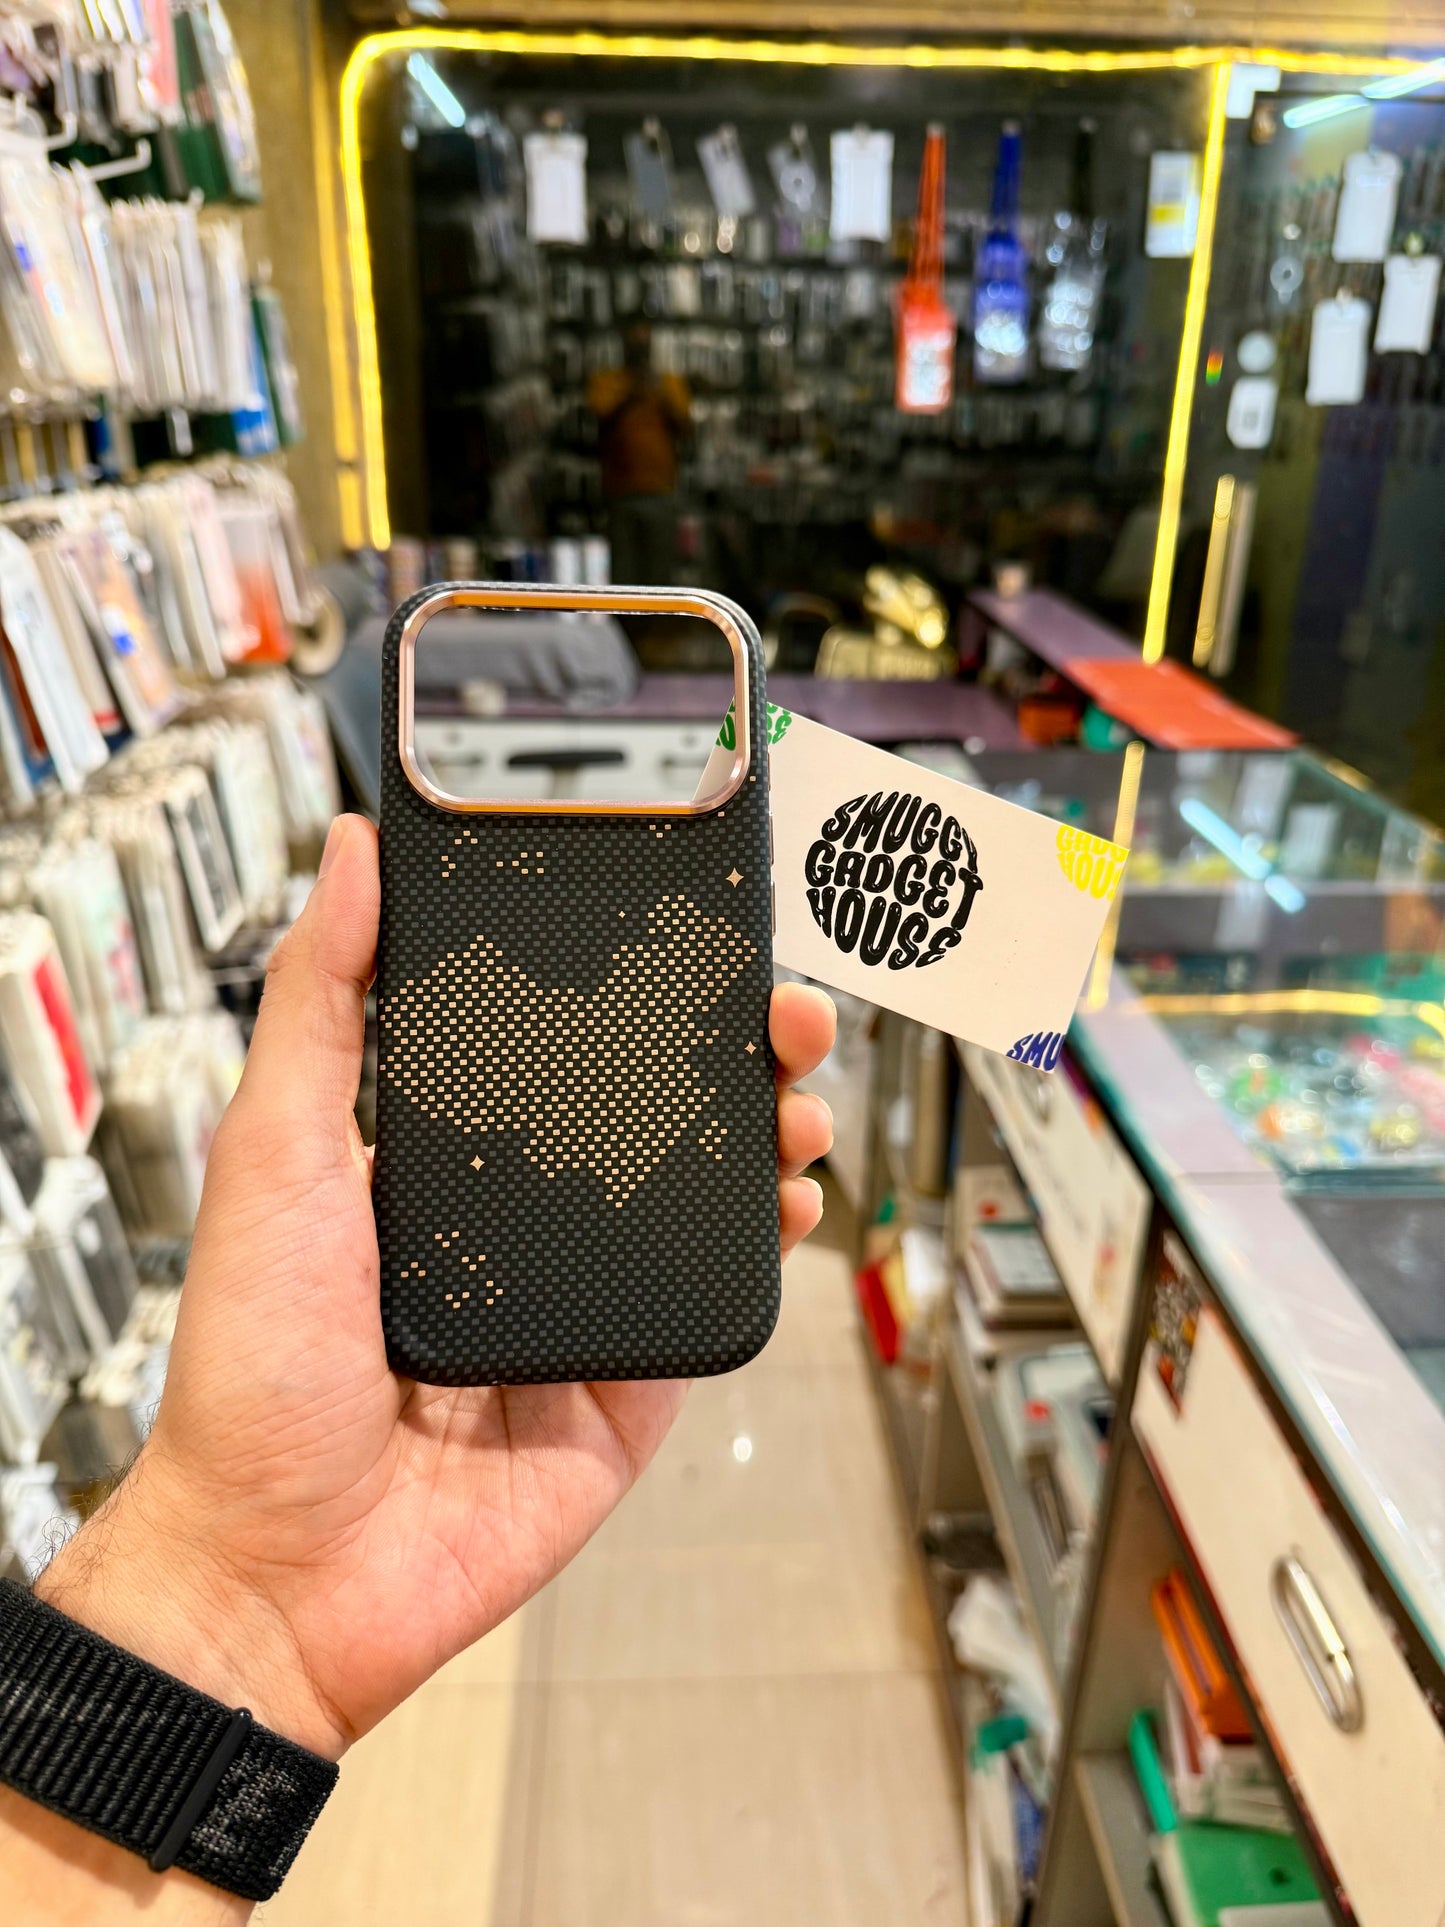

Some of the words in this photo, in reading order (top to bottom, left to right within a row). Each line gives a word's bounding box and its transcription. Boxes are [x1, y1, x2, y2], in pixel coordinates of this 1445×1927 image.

[805, 839, 983, 930] GADGET
[806, 886, 962, 970] HOUSE
[1006, 1031, 1066, 1071] SMU
